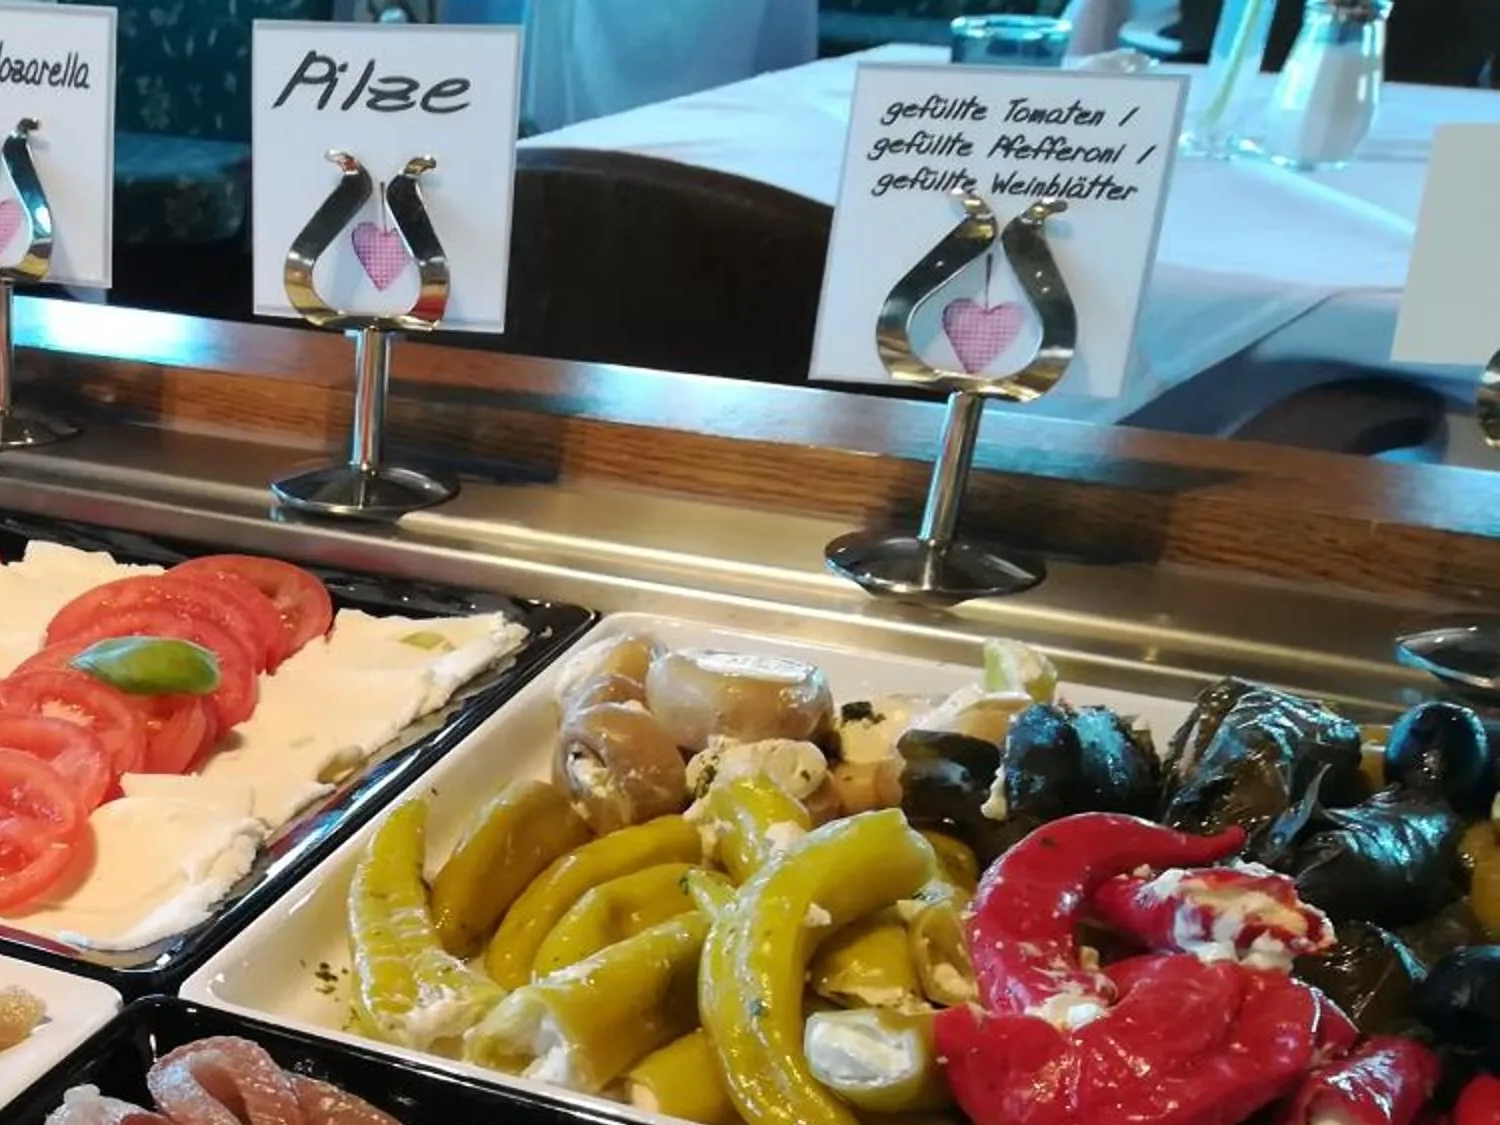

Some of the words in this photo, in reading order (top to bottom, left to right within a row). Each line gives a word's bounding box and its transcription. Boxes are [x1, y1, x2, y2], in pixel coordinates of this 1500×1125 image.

[271, 49, 471, 114] Pilze
[880, 94, 989, 126] gefüllte
[1004, 97, 1106, 127] Tomaten
[866, 130, 975, 161] gefüllte
[987, 133, 1128, 165] Pfefferoni
[991, 170, 1140, 201] Weinblätter
